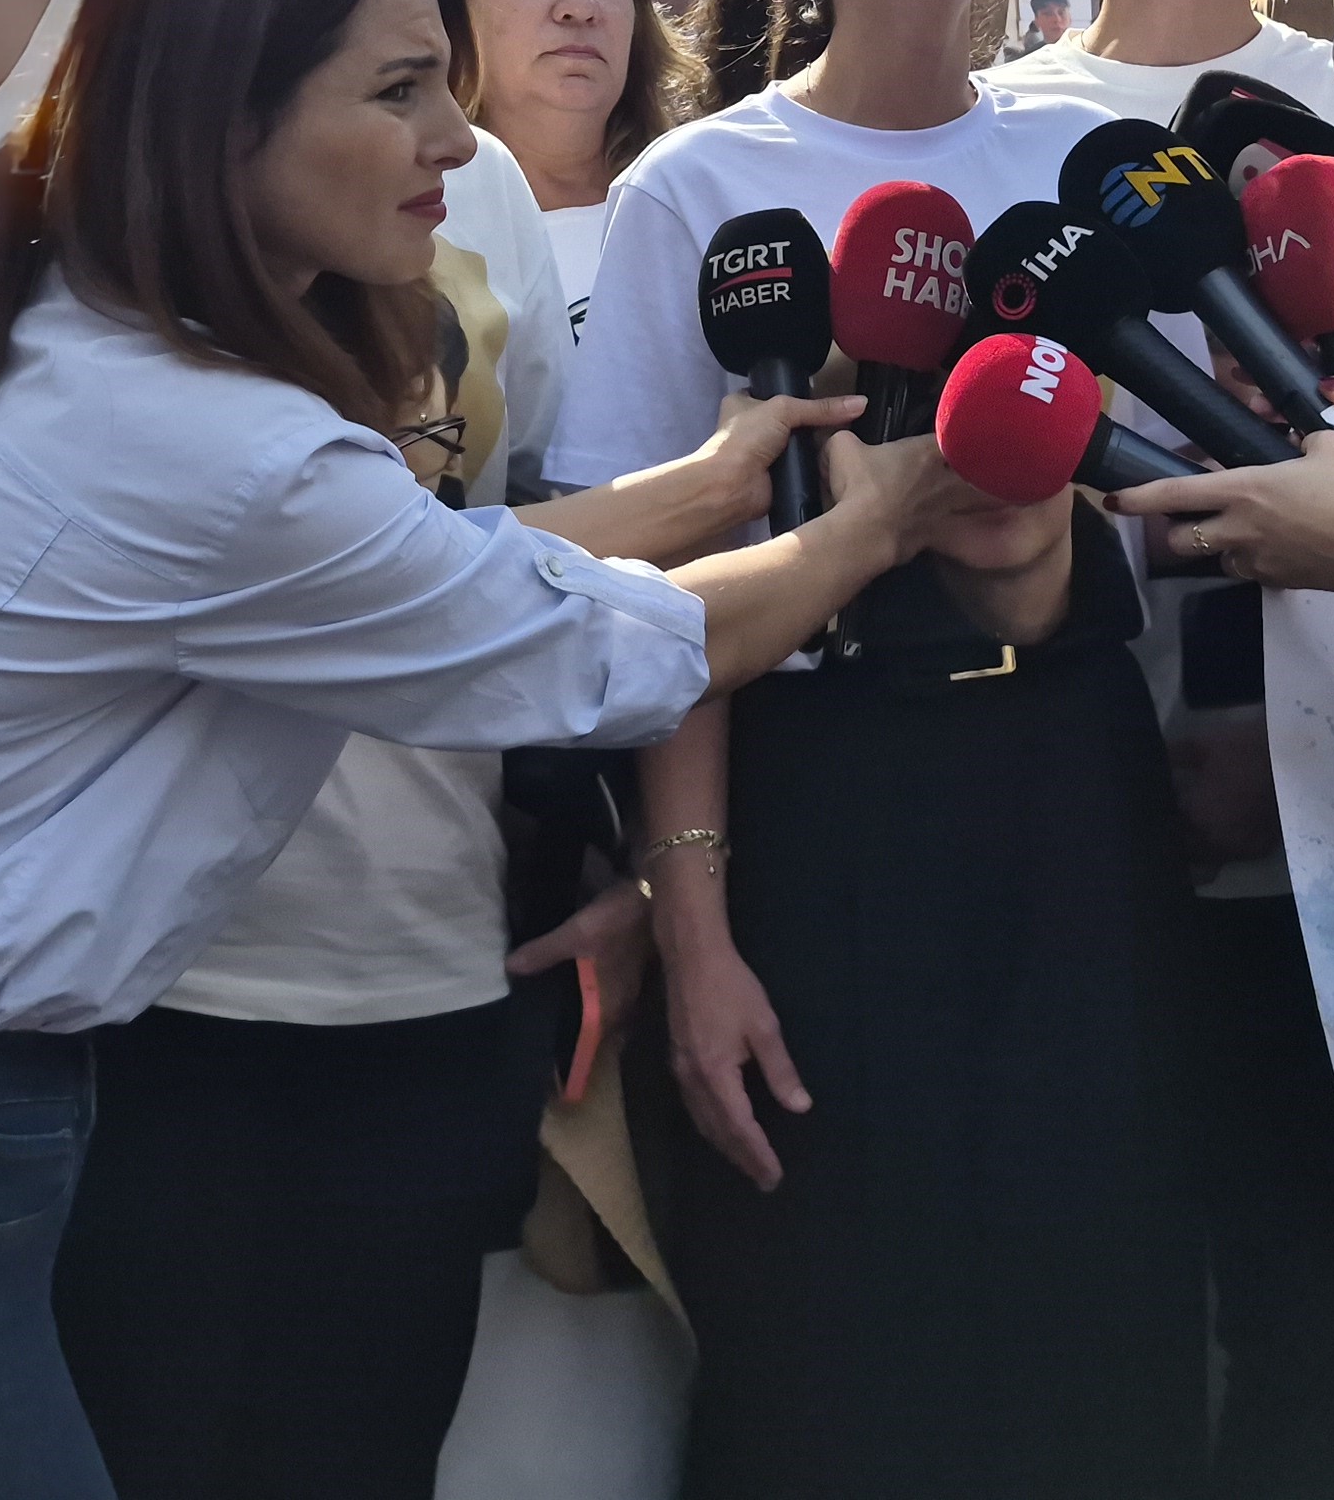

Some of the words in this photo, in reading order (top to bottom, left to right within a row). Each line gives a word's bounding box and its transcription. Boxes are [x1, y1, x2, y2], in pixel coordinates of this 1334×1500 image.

[708, 240, 791, 279] TGRT
[890, 227, 971, 279] SHO
[1020, 224, 1095, 282] İHA
[710, 281, 792, 317] HABER
